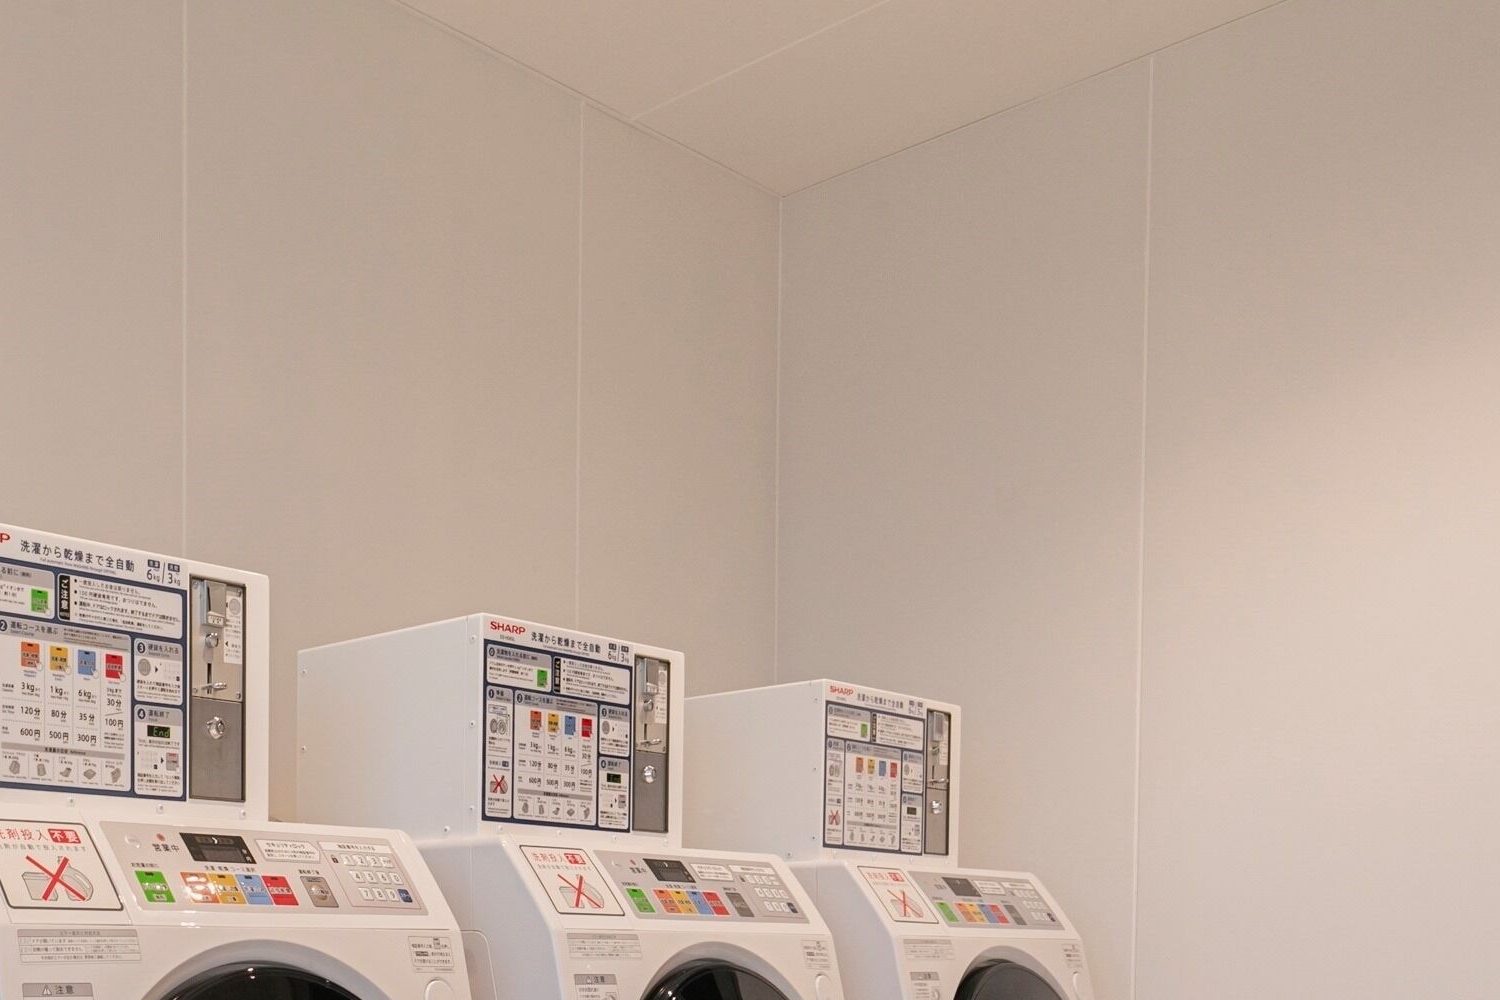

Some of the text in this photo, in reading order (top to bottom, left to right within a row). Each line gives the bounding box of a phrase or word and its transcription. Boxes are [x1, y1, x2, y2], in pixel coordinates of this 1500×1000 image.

[20, 539, 135, 573] 洗濯から乾燥まで全自動
[490, 620, 527, 636] SHARP
[829, 685, 855, 697] SHARP
[152, 727, 171, 738] End
[54, 984, 76, 995] 注意
